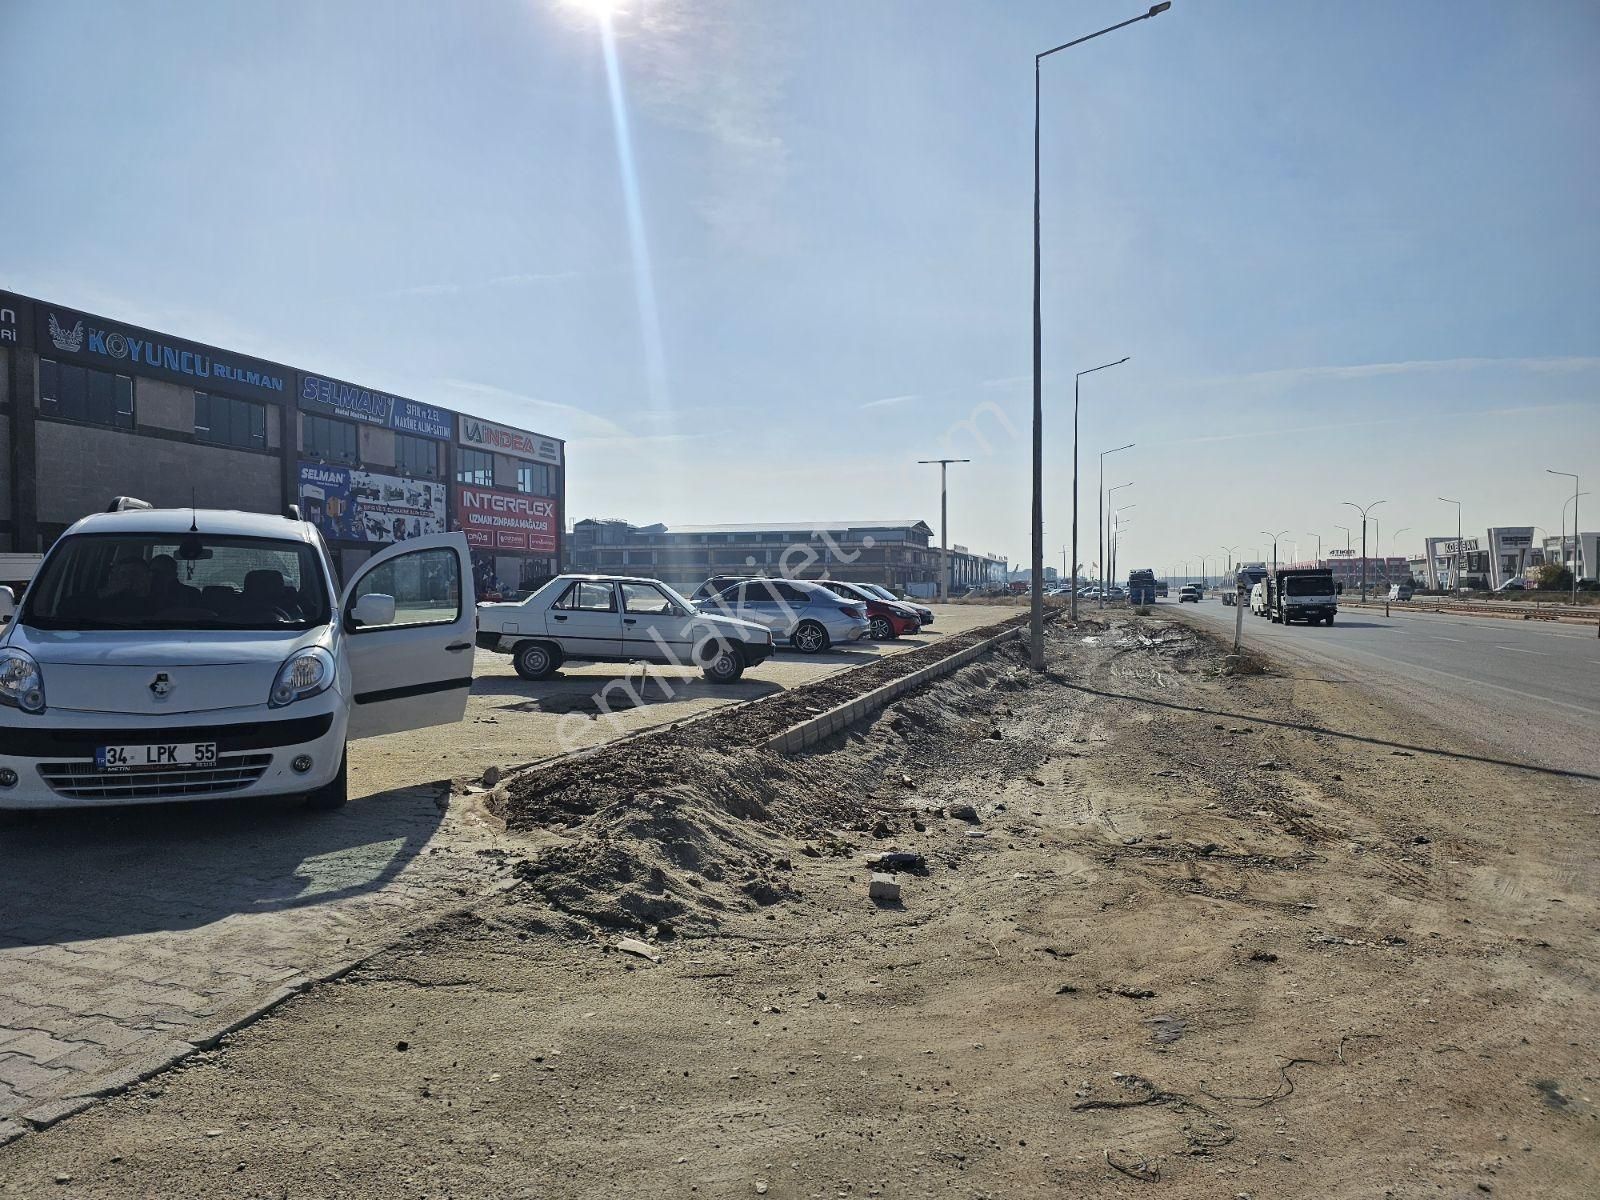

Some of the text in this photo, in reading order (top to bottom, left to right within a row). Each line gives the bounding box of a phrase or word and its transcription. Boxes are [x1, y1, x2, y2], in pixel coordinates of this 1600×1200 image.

[88, 327, 284, 392] KOYUNCU RULMAN
[303, 376, 387, 417] SELMAN
[301, 467, 343, 484] SELMAN
[463, 490, 553, 517] INTERFLEX
[468, 513, 492, 526] UZMAN
[106, 743, 215, 765] 34 LPK 55
